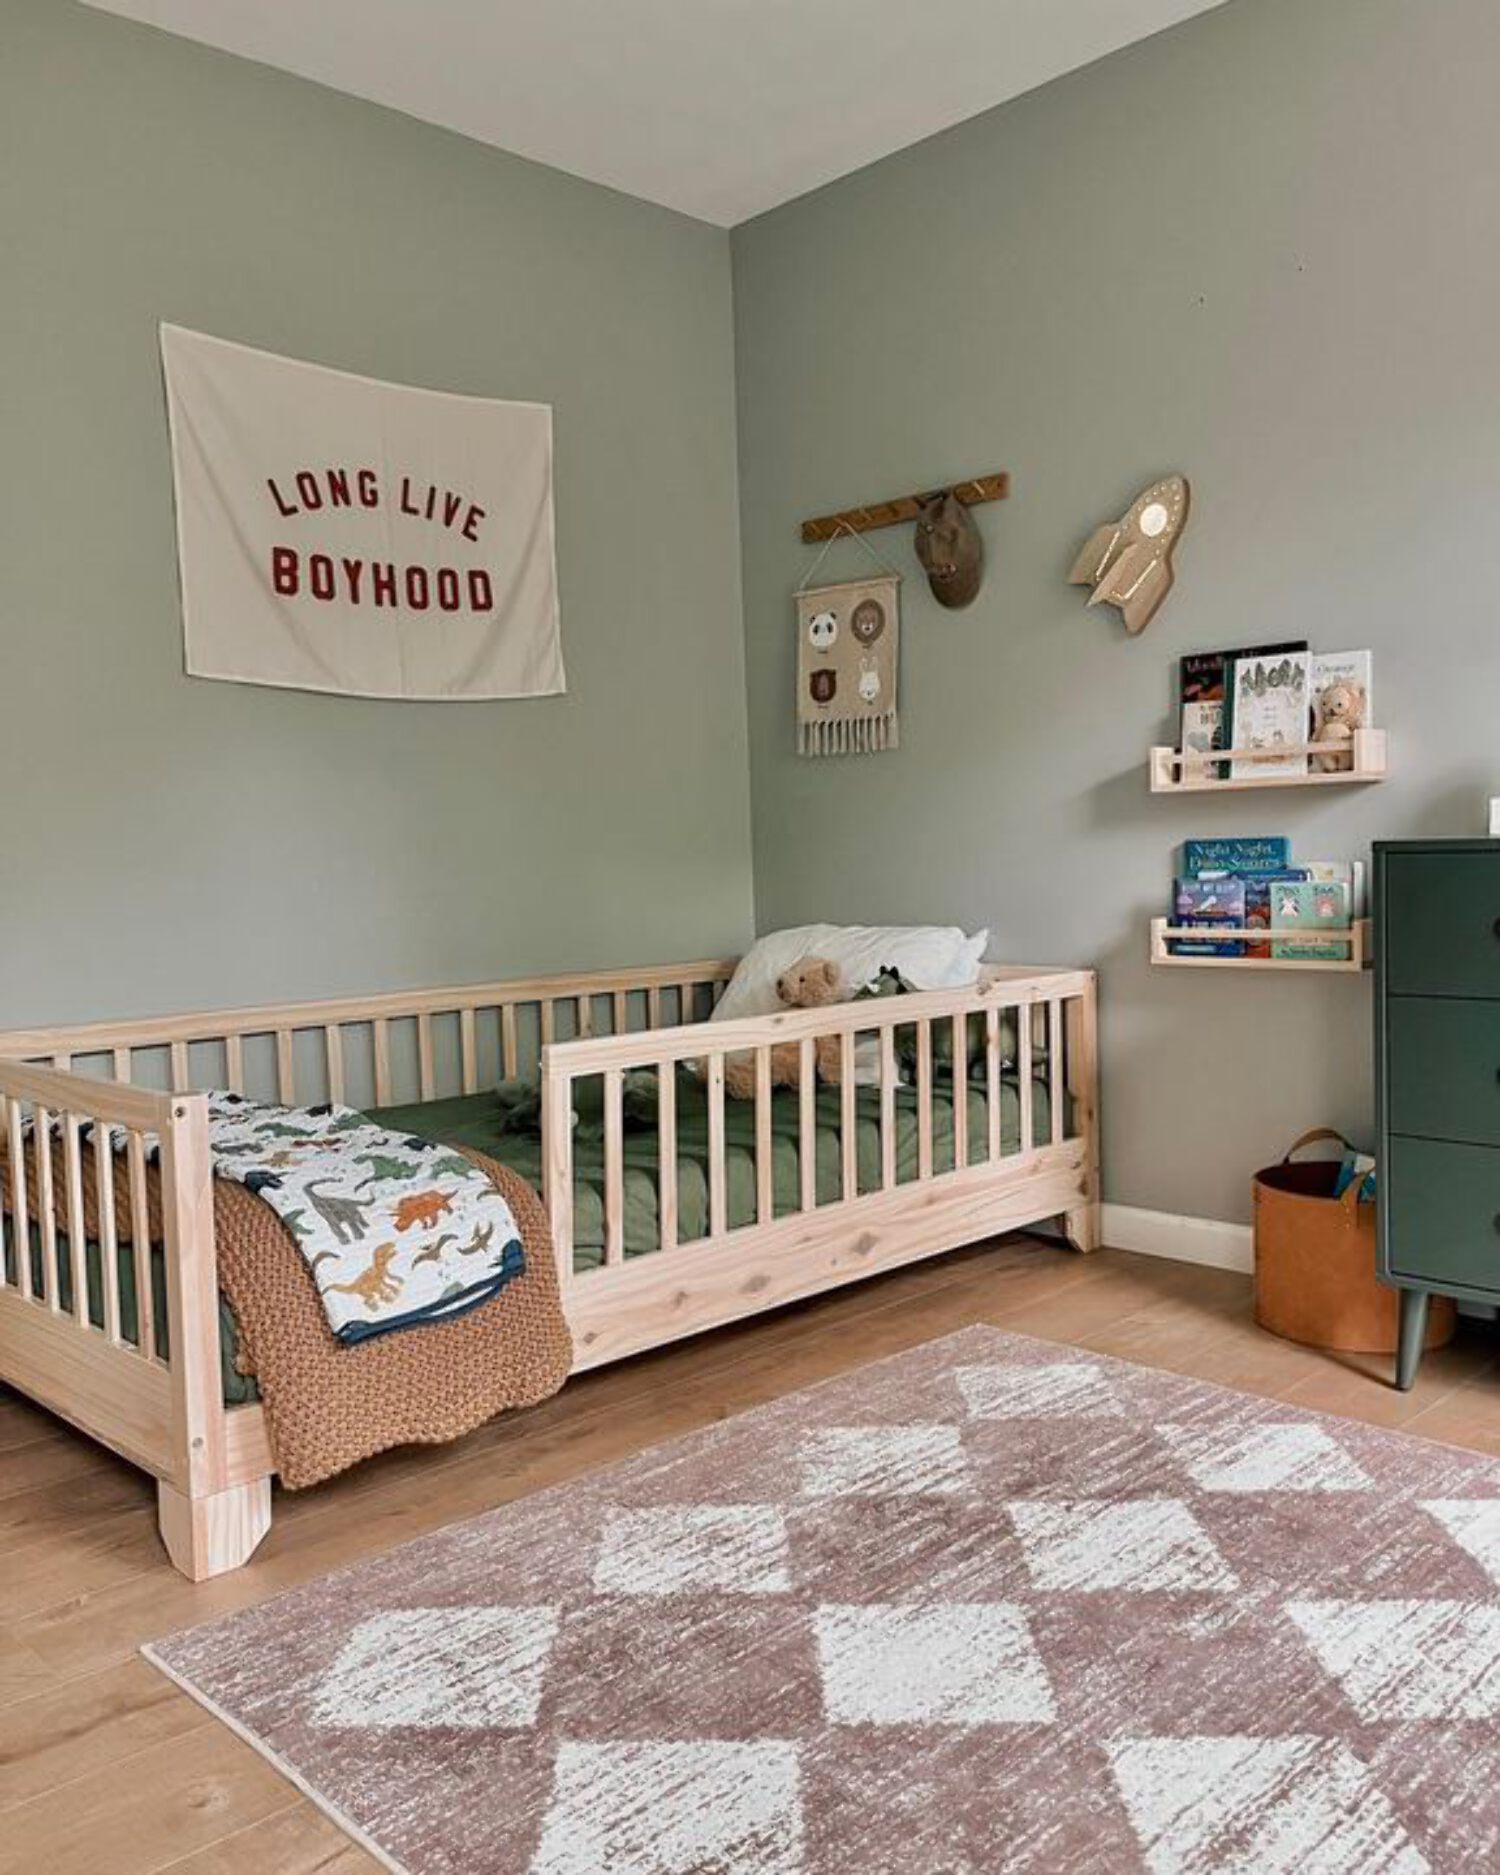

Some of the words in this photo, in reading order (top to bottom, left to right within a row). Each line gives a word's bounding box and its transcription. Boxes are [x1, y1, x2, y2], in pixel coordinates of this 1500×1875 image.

[267, 468, 379, 517] LONG
[401, 477, 486, 542] LIVE
[272, 546, 494, 611] BOYHOOD
